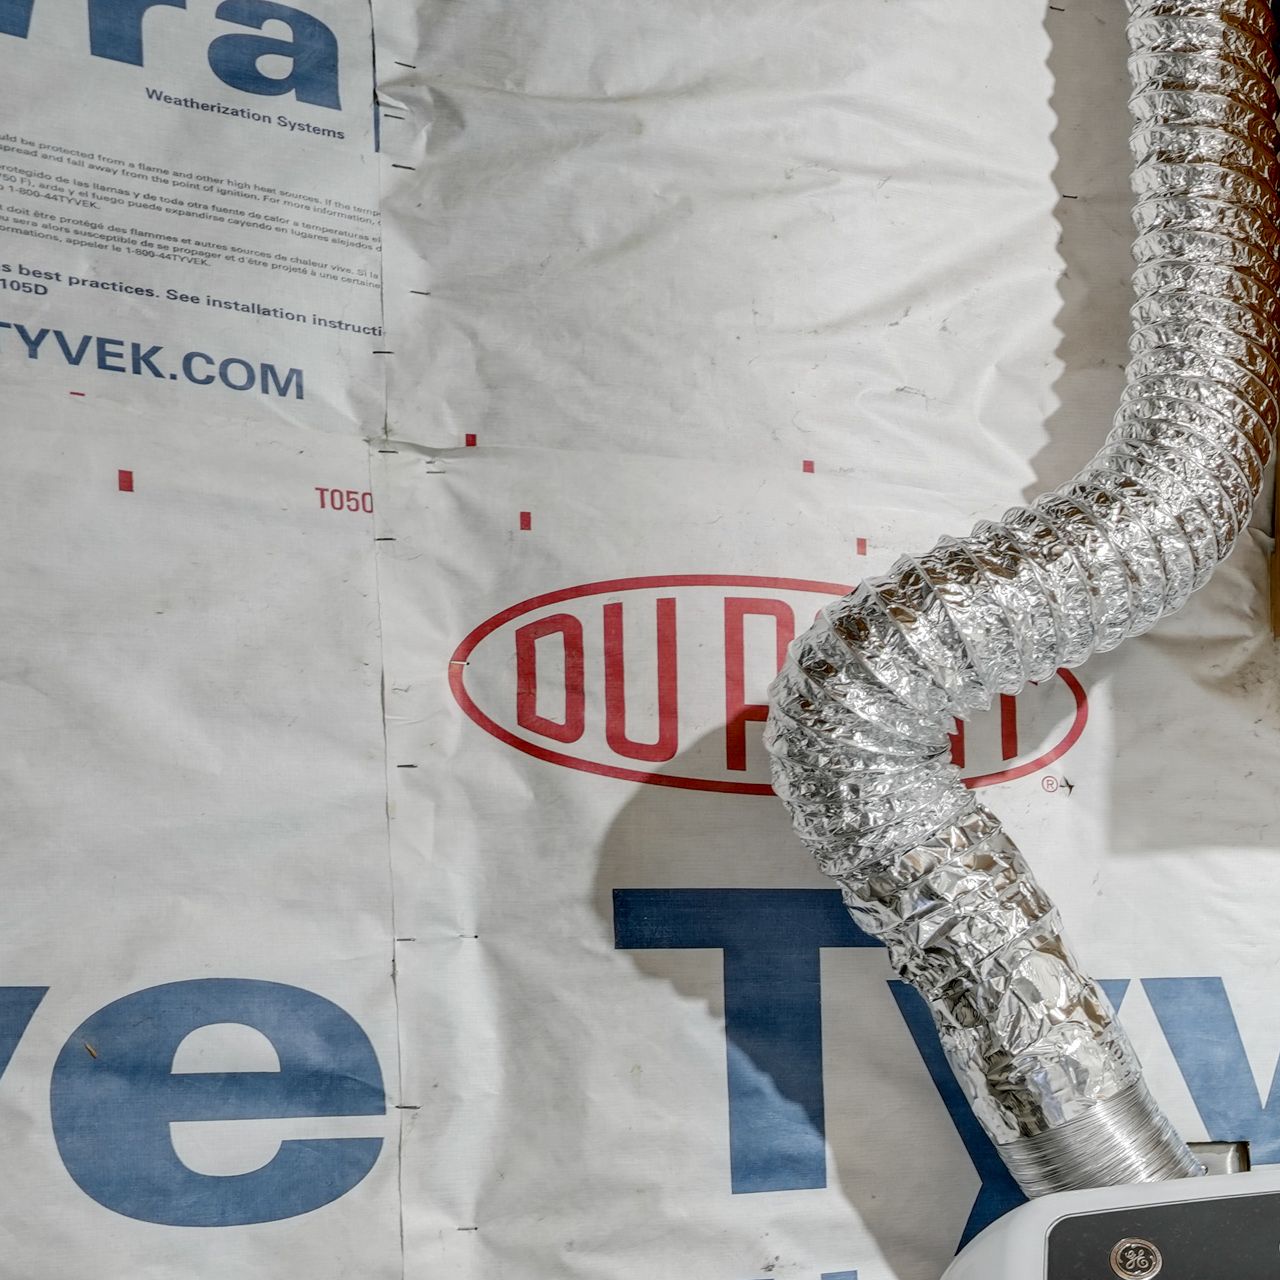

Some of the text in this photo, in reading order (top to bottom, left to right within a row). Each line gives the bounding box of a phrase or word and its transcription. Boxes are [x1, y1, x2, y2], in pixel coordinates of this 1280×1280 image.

[0, 0, 342, 111] ra
[145, 87, 345, 140] Weatherization Systems
[39, 143, 276, 194] protected from flame other high heat
[66, 156, 310, 210] fall away from point ignition. more
[6, 203, 327, 269] doit être protégé flammes autres sources chaleur
[38, 182, 372, 250] arde fuego puede expandirse cayendo lugares alejados
[92, 181, 368, 240] llamas toda otra fuente calor temperaturas
[12, 216, 306, 274] sera alors susceptible propager projeté
[66, 237, 107, 250] appeler
[18, 263, 61, 282] best
[68, 275, 159, 297] practices.
[166, 288, 200, 304] See
[206, 294, 306, 322] installation
[0, 976, 388, 1227] e
